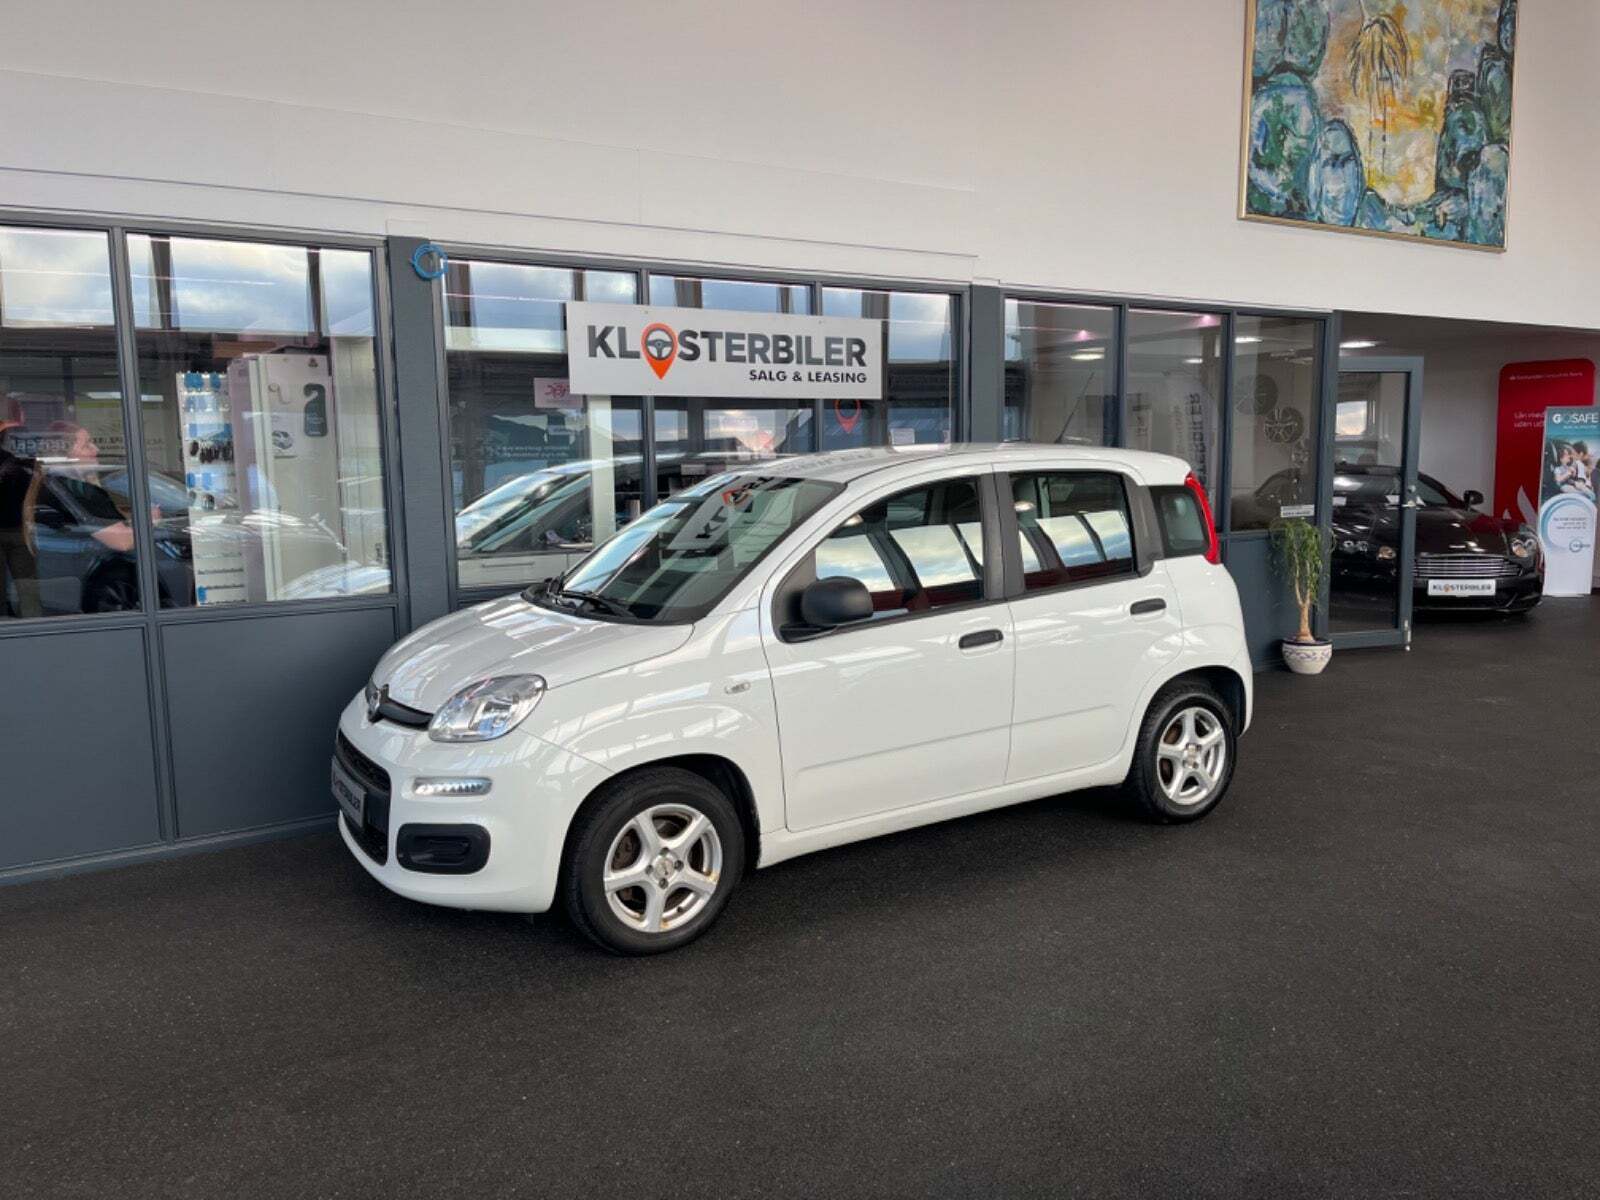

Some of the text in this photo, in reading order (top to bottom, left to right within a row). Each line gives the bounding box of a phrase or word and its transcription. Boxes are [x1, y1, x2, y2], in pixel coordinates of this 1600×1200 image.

[587, 323, 867, 370] KLOSTERBILER
[749, 369, 867, 383] SALG & LEASING
